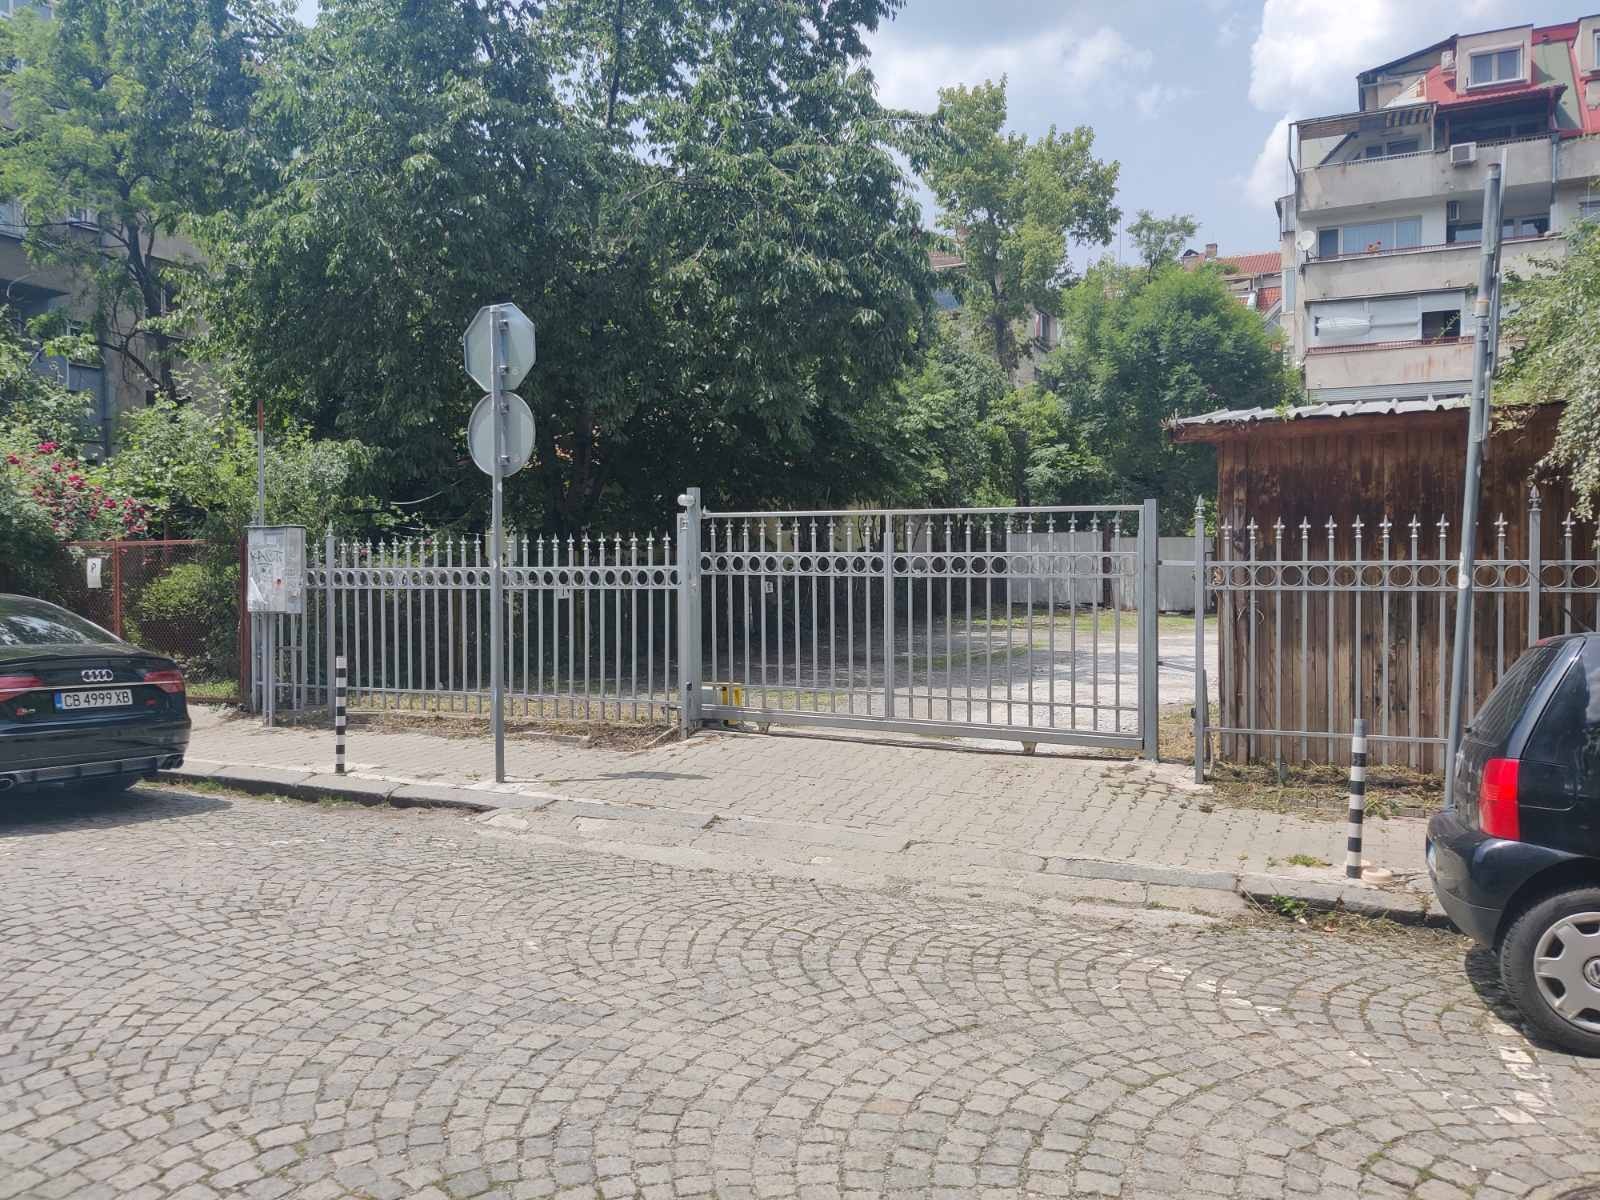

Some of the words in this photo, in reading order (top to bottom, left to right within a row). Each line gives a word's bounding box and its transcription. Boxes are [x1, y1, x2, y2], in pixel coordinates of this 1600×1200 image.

[64, 694, 80, 707] CB
[84, 692, 112, 706] 4999
[115, 691, 129, 704] XB
